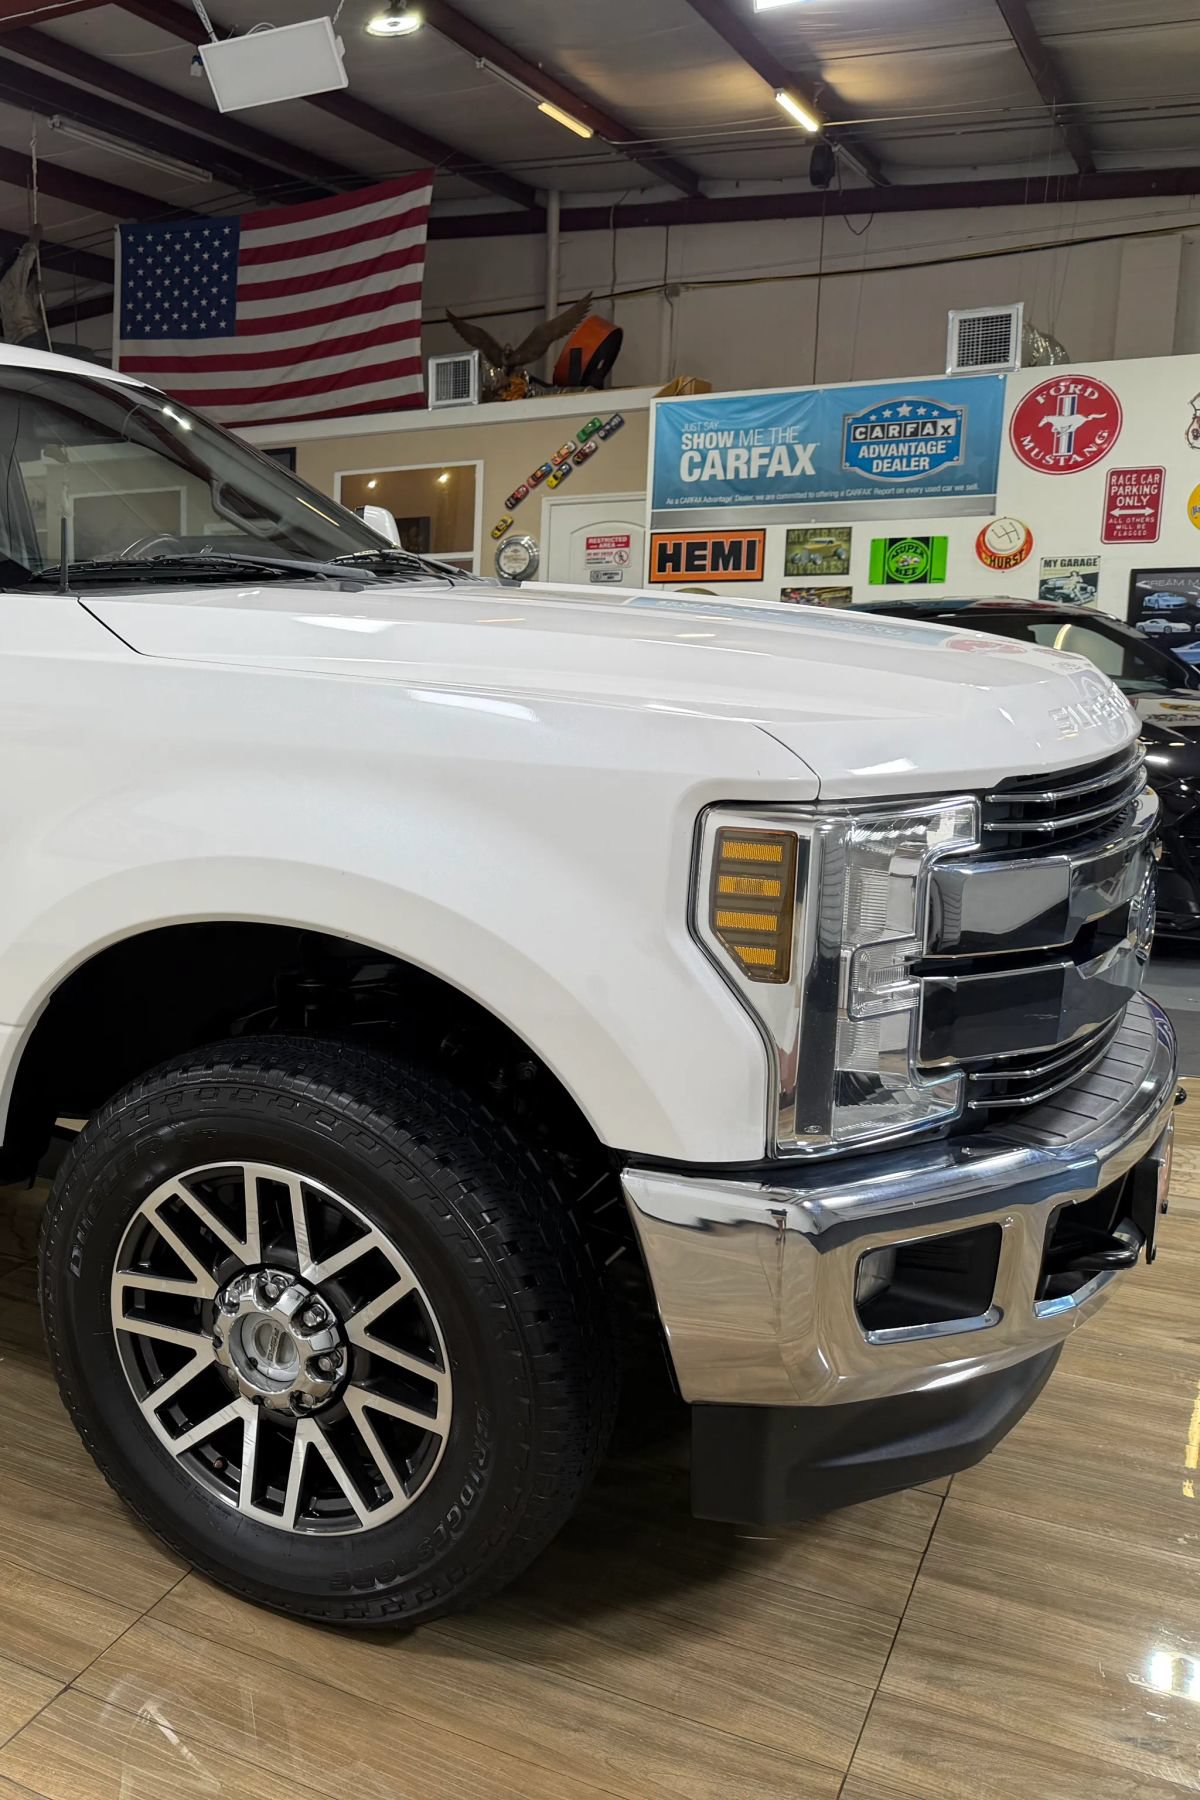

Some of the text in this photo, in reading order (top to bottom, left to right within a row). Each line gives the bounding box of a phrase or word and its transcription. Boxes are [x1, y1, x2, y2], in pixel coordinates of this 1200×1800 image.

[1035, 383, 1099, 404] FORD
[680, 420, 720, 433] JUST SAY
[854, 421, 953, 441] CARFAX
[681, 425, 800, 450] SHOW ME THE
[858, 440, 947, 459] ADVANTAGE
[1020, 429, 1109, 466] MUSTANG
[679, 443, 817, 483] CARFAX
[872, 458, 930, 473] DEALER
[1111, 473, 1160, 486] RACE CAR
[873, 487, 895, 496] Report
[906, 487, 923, 495] every
[925, 484, 940, 493] used
[1110, 484, 1159, 496] PARKING
[1116, 495, 1151, 507] ONLY
[1126, 516, 1155, 524] OTHERS
[657, 539, 758, 574] HEMI
[989, 549, 1024, 569] HURST
[1043, 557, 1098, 568] MY GARAGE
